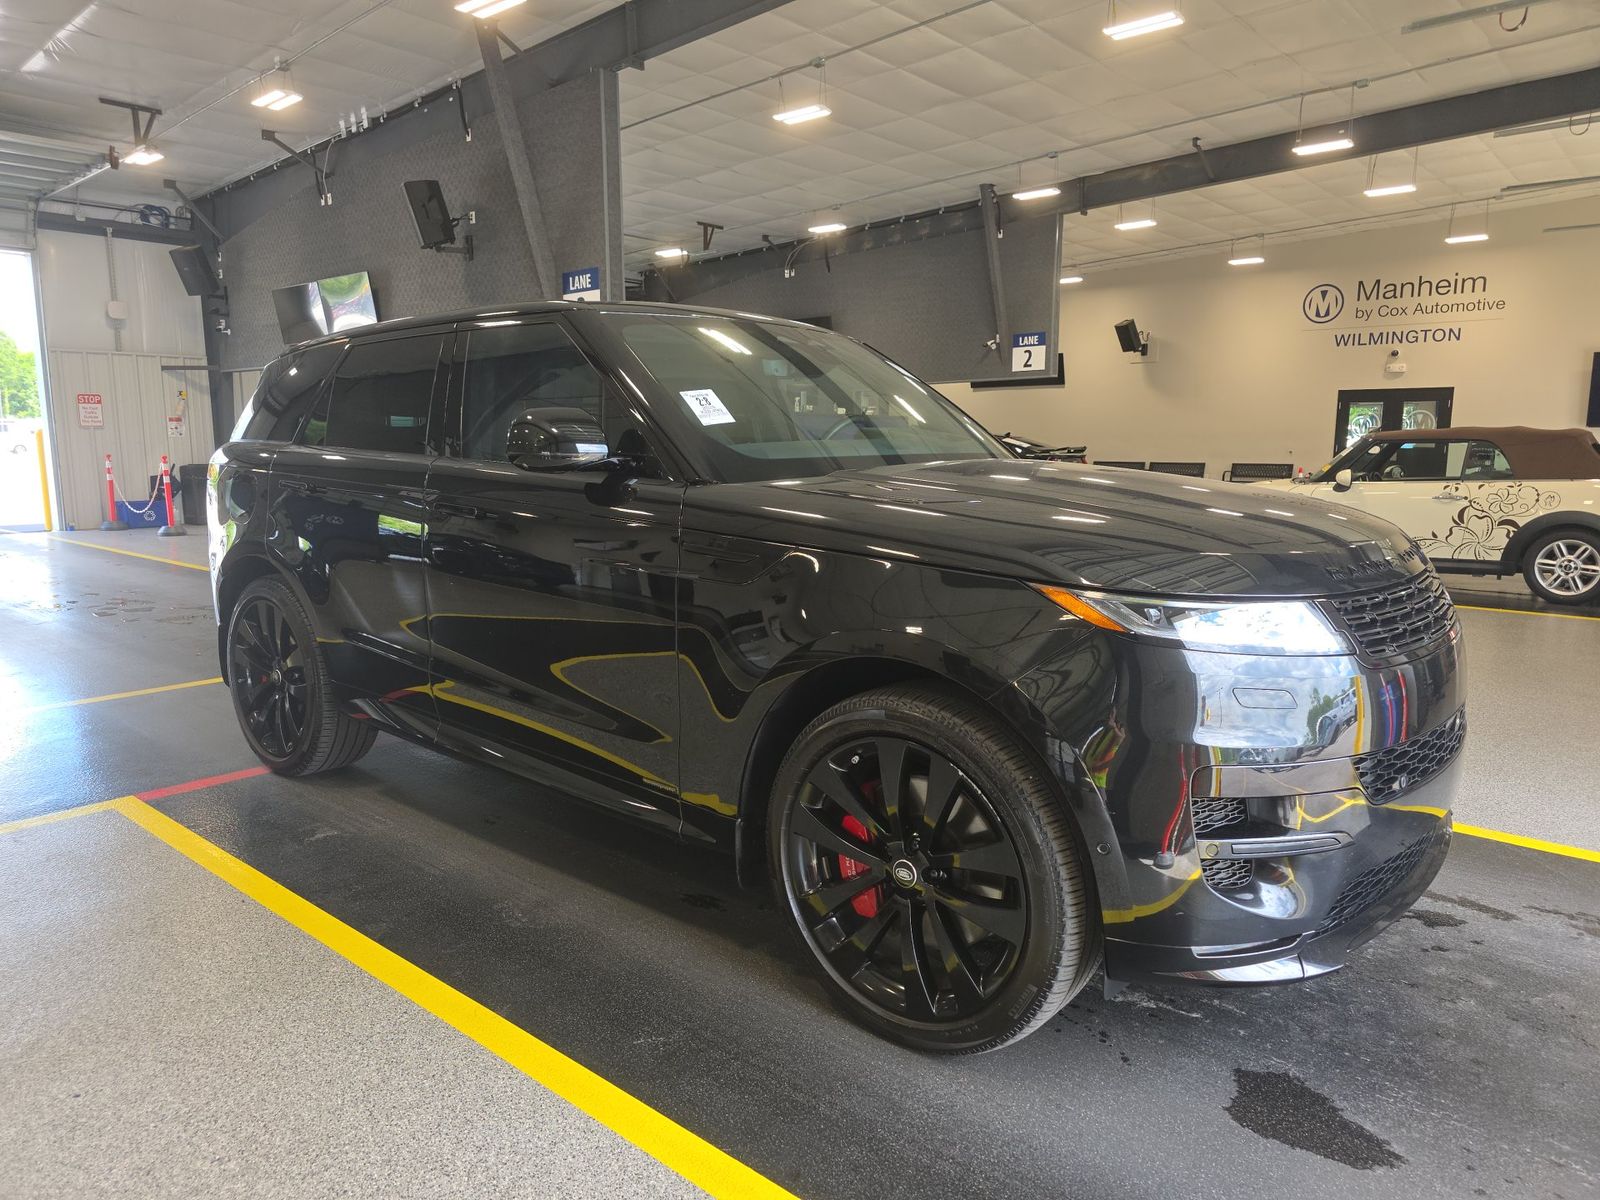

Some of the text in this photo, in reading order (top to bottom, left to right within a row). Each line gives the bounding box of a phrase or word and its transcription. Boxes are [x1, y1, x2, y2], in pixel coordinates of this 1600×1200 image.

[569, 273, 592, 290] LANE
[1356, 272, 1487, 301] Manheim
[1355, 298, 1506, 321] by Cox Automotive
[1019, 335, 1039, 346] LANE
[1334, 327, 1462, 347] WILMINGTON
[1023, 349, 1032, 368] 2
[78, 395, 101, 404] STOP
